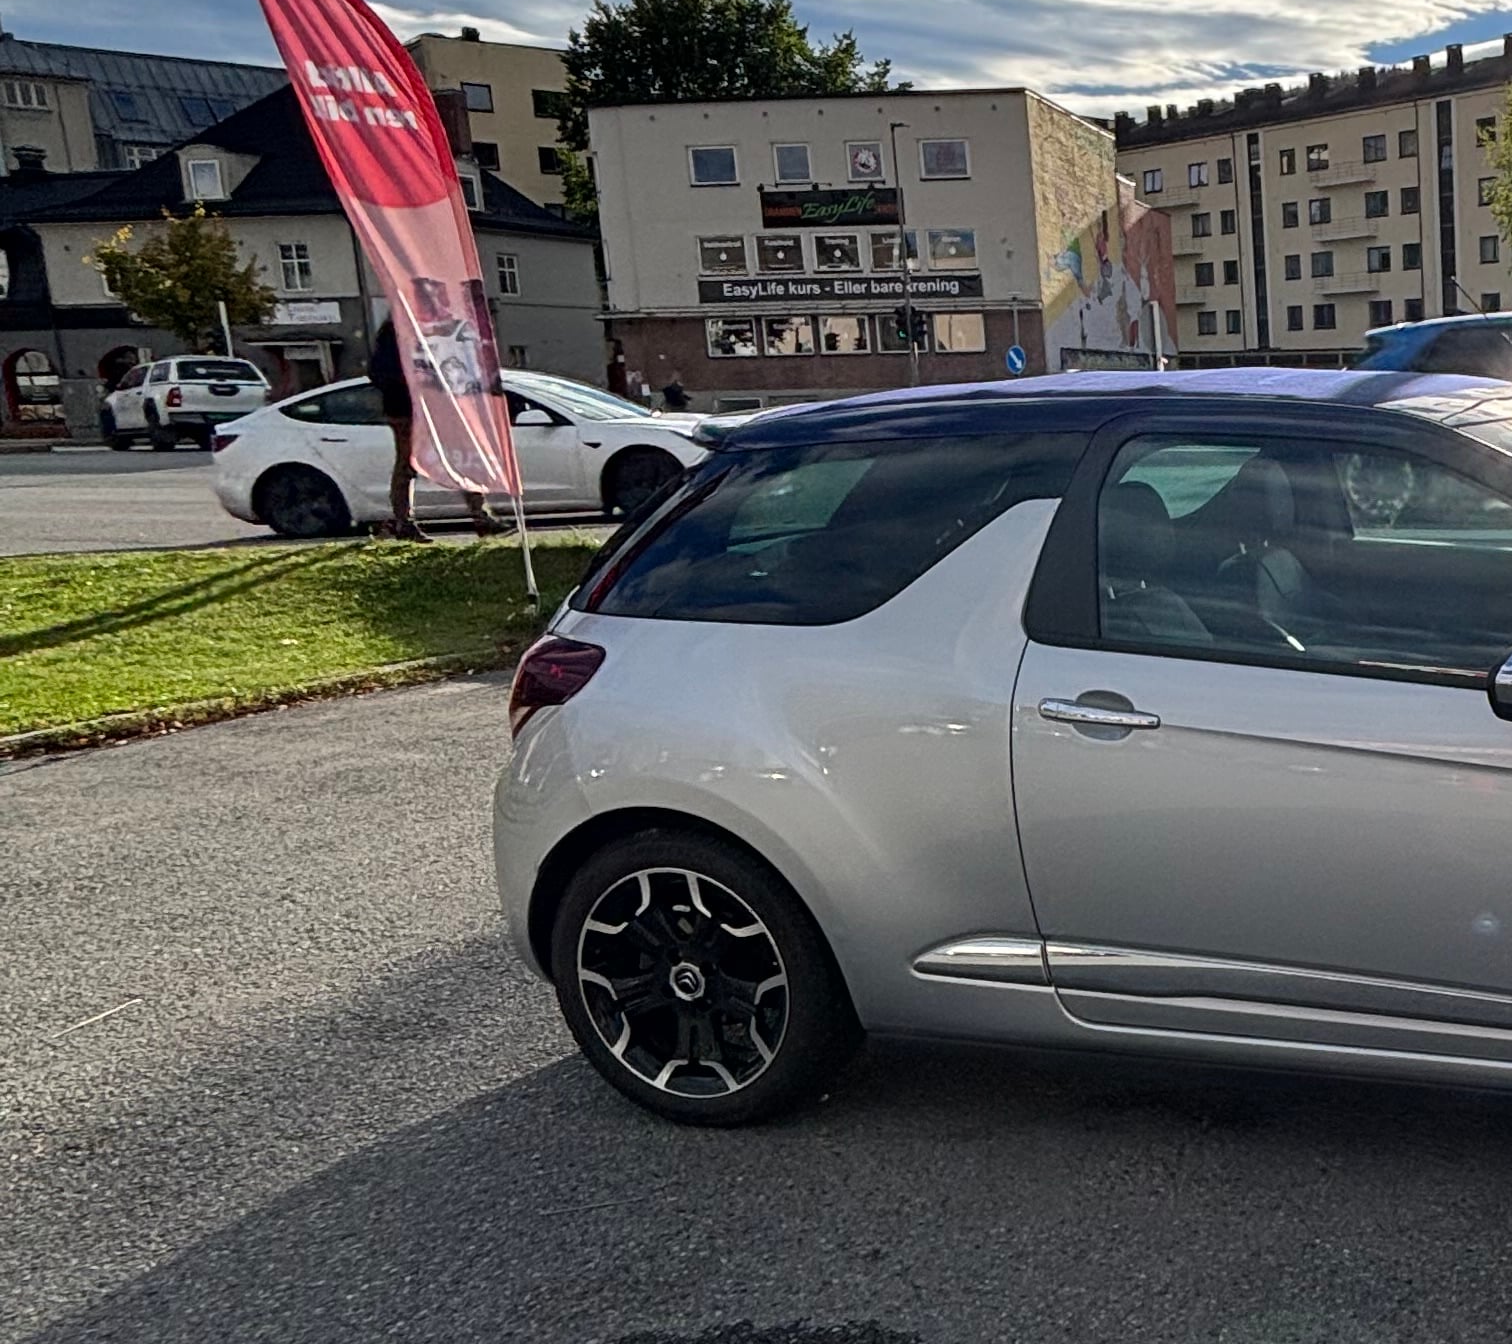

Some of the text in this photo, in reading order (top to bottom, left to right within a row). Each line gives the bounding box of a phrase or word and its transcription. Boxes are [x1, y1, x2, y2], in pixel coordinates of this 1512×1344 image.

[800, 191, 876, 223] EasyLife
[722, 281, 785, 299] EasyLife
[788, 281, 821, 295] kurs
[833, 280, 868, 295] Eller
[870, 280, 904, 294] bare
